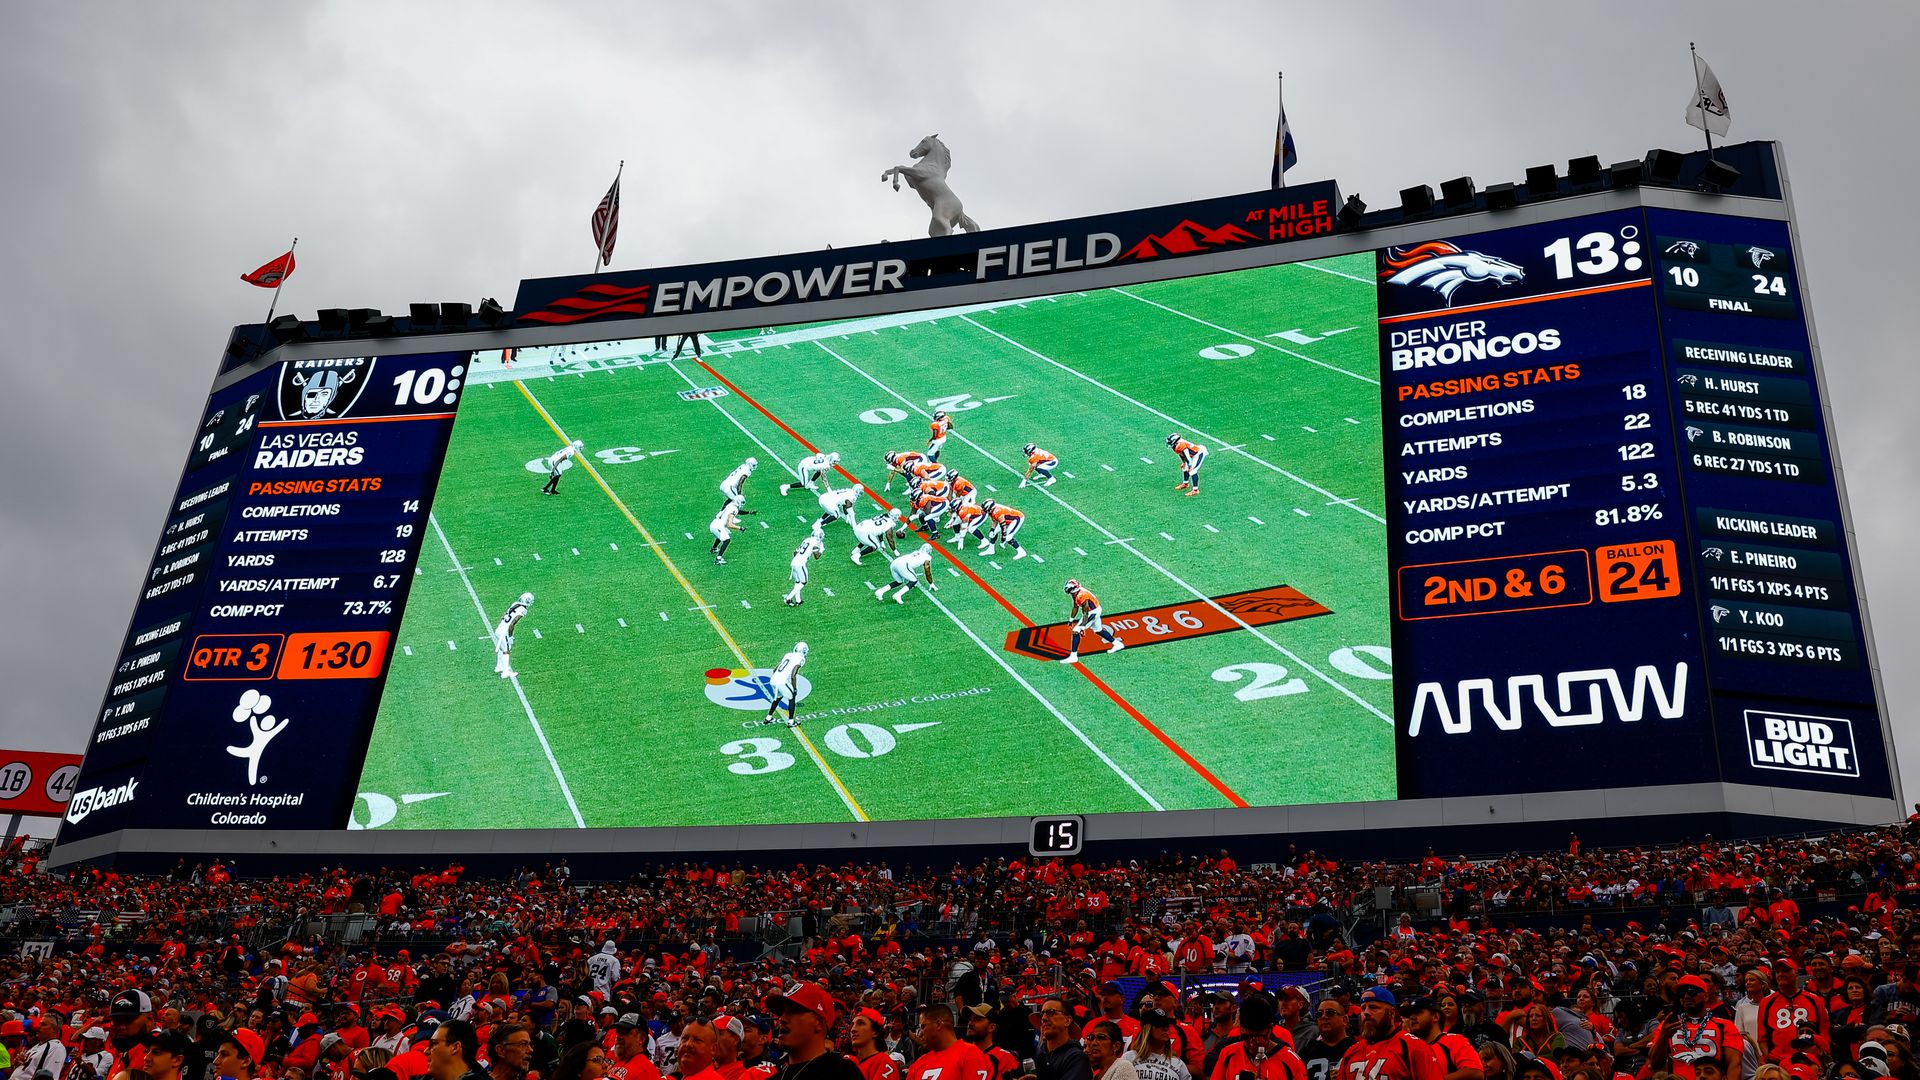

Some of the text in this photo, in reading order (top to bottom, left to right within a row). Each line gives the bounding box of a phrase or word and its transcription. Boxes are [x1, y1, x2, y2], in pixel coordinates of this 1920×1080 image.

[1245, 199, 1329, 223] AT MILE
[1269, 216, 1333, 240] HIGH
[1543, 231, 1620, 280] 13
[653, 231, 1122, 314] EMPOWER FIELD
[1668, 266, 1699, 287] 10
[1751, 274, 1787, 296] 24
[1708, 298, 1752, 313] FINAL
[1391, 320, 1486, 348] DENVER
[1392, 329, 1562, 372] BRONCOS
[1685, 346, 1793, 369] RECEIVING LEADER
[294, 357, 366, 369] RAIDERS
[393, 368, 446, 406] 10
[1399, 364, 1581, 401] PASSING STATS
[1622, 384, 1647, 400] 18
[1704, 377, 1759, 394] H. HURST
[1400, 399, 1535, 428] COMPLETIONS
[1624, 413, 1651, 430] 22
[1685, 400, 1789, 422] 5 REC 41 YDS 1 TD
[235, 414, 255, 436] 24
[200, 433, 214, 451] 10
[259, 431, 358, 449] LAS VEGAS
[1401, 432, 1503, 456] ATTEMPTS
[1712, 430, 1792, 450] B. ROBINSON
[208, 447, 229, 461] FINAL
[253, 447, 365, 470] RAIDERS
[1618, 442, 1655, 461] 122
[1402, 465, 1468, 485] YARDS
[1693, 454, 1800, 476] 6 REC 27 YDS 1 TD
[249, 477, 383, 496] PASSING STATS
[1621, 472, 1658, 492] 5.3
[180, 482, 230, 511] RECEIVING LEADER
[402, 500, 419, 513] 14
[1404, 483, 1571, 514] YARDS/ATTEMPT
[185, 513, 206, 530] HURST
[242, 504, 341, 519] COMPLETIONS
[1595, 504, 1663, 526] 81.8%
[233, 529, 308, 543] ATTEMPTS
[395, 524, 413, 538] 19
[1405, 521, 1506, 544] COMP PCT
[1716, 516, 1818, 539] KICKING LEADER
[227, 554, 275, 568] YARDS
[380, 550, 406, 564] 128
[1606, 544, 1665, 559] BALL ON
[1731, 550, 1797, 569] E. PINEIRO
[170, 552, 200, 573] ROBINSON
[218, 577, 339, 592] YARDS/ATTEMPT
[373, 575, 400, 589] 6.7
[1423, 564, 1566, 606] 2ND & 6
[1608, 558, 1671, 596] 24
[1710, 576, 1829, 600] 1/1 FGS 1 XPS 4 PTS
[209, 604, 284, 618] COMP PCT
[342, 601, 392, 616] 73.7%
[1739, 609, 1784, 627] Y. KOO
[1141, 615, 1174, 635] &
[1173, 610, 1204, 630] 6
[135, 621, 182, 646] KICKING LEADER
[194, 643, 269, 671] QTR 3
[301, 641, 372, 670] 1:30
[1719, 637, 1841, 661] 1/1 FGS 3 XPS 6 PTS
[832, 686, 992, 716] Hospital Colorado
[1408, 661, 1688, 737] ARROW
[1764, 717, 1834, 746] BUD
[1755, 739, 1849, 770] LIGHT
[1, 769, 27, 792] 18
[187, 792, 304, 809] Children's Hospital
[211, 812, 267, 825] Colorado
[1048, 822, 1073, 849] 15
[1087, 897, 1100, 907] 33
[1050, 938, 1058, 949] 2
[1187, 948, 1198, 962] 10
[387, 969, 401, 981] 58
[591, 964, 608, 980] 24
[1776, 1007, 1808, 1029] 88
[882, 1064, 893, 1079] 7
